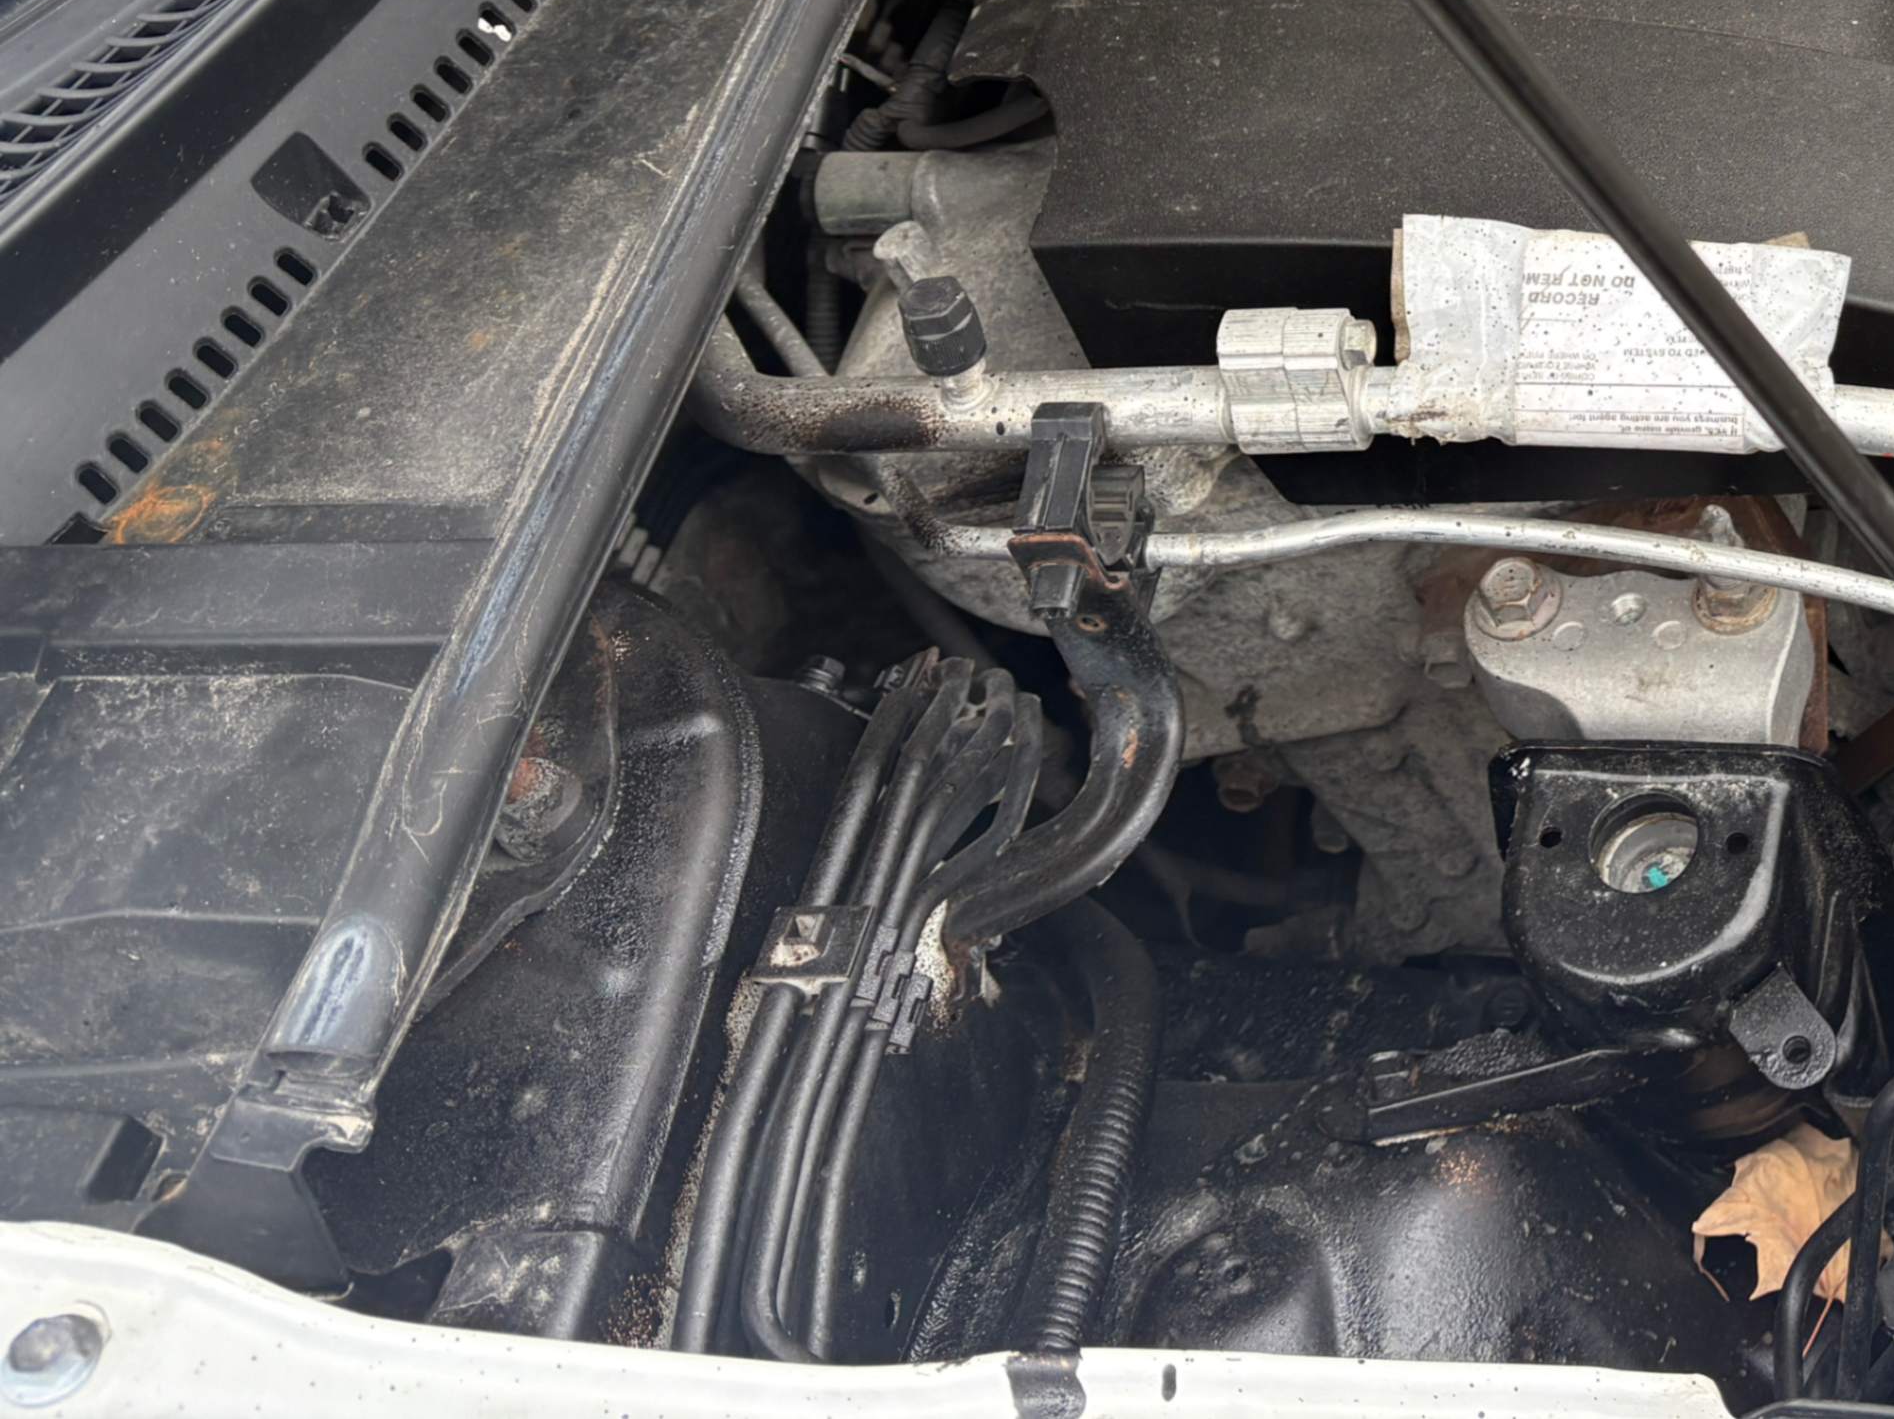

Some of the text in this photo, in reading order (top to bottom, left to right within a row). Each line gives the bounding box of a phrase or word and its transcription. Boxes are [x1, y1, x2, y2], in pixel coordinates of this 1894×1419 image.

[1566, 274, 1606, 287] NOT
[1610, 275, 1636, 288] DO
[1527, 292, 1600, 306] RECORD
[1587, 412, 1617, 422] agent
[1620, 413, 1650, 424] acting
[1654, 415, 1669, 423] are
[1672, 413, 1691, 423] you
[1693, 414, 1738, 424] business
